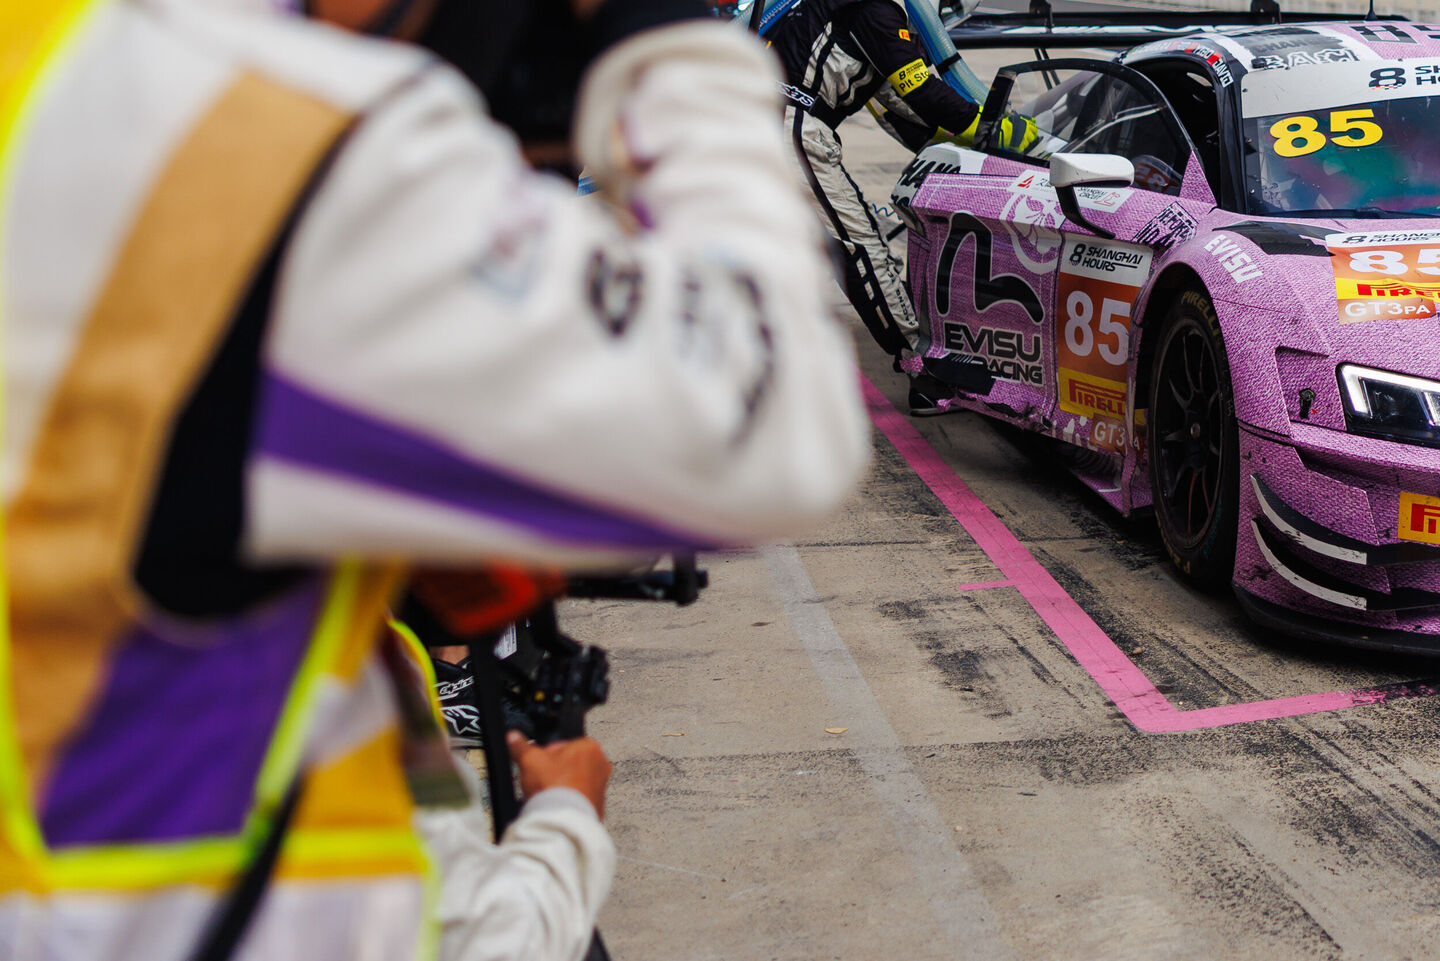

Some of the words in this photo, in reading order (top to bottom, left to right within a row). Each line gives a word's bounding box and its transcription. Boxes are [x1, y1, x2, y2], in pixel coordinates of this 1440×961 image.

[1368, 66, 1407, 92] 8
[1269, 108, 1384, 158] 85
[1069, 243, 1086, 266] 8
[1086, 246, 1143, 265] SHANGHAI
[1082, 258, 1116, 272] HOURS
[1204, 234, 1264, 284] EVISU
[943, 321, 1042, 363] EVISU
[1064, 290, 1132, 366] 85
[1068, 378, 1128, 416] PIRELL
